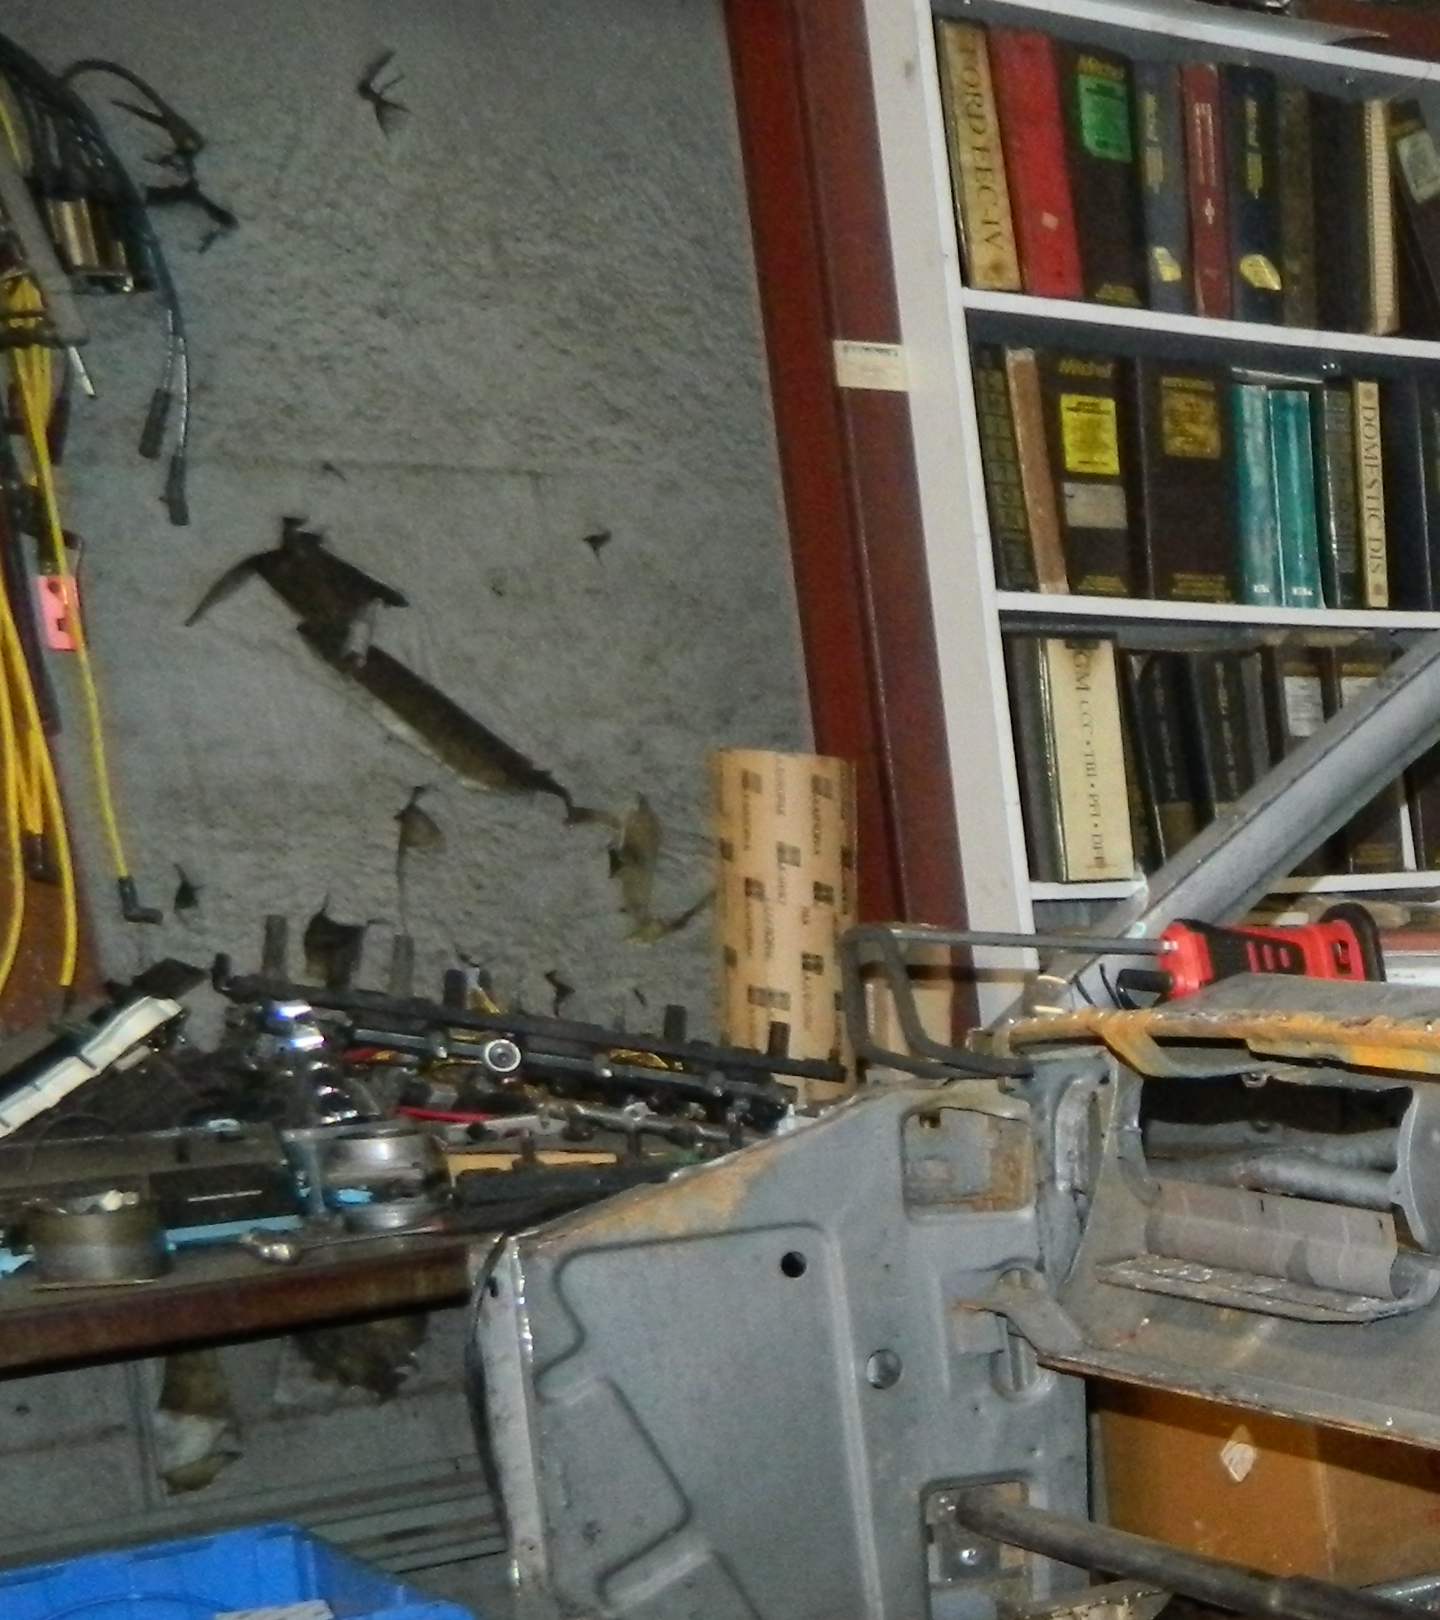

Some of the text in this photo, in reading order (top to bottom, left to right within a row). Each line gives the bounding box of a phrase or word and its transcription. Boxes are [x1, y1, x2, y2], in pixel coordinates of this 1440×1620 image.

[961, 46, 1004, 249] FORD EEC-IV
[1361, 406, 1384, 574] DOMESTIC DIS
[1073, 651, 1090, 691] GM
[1080, 701, 1094, 736] CCC
[1085, 753, 1098, 777] TBI
